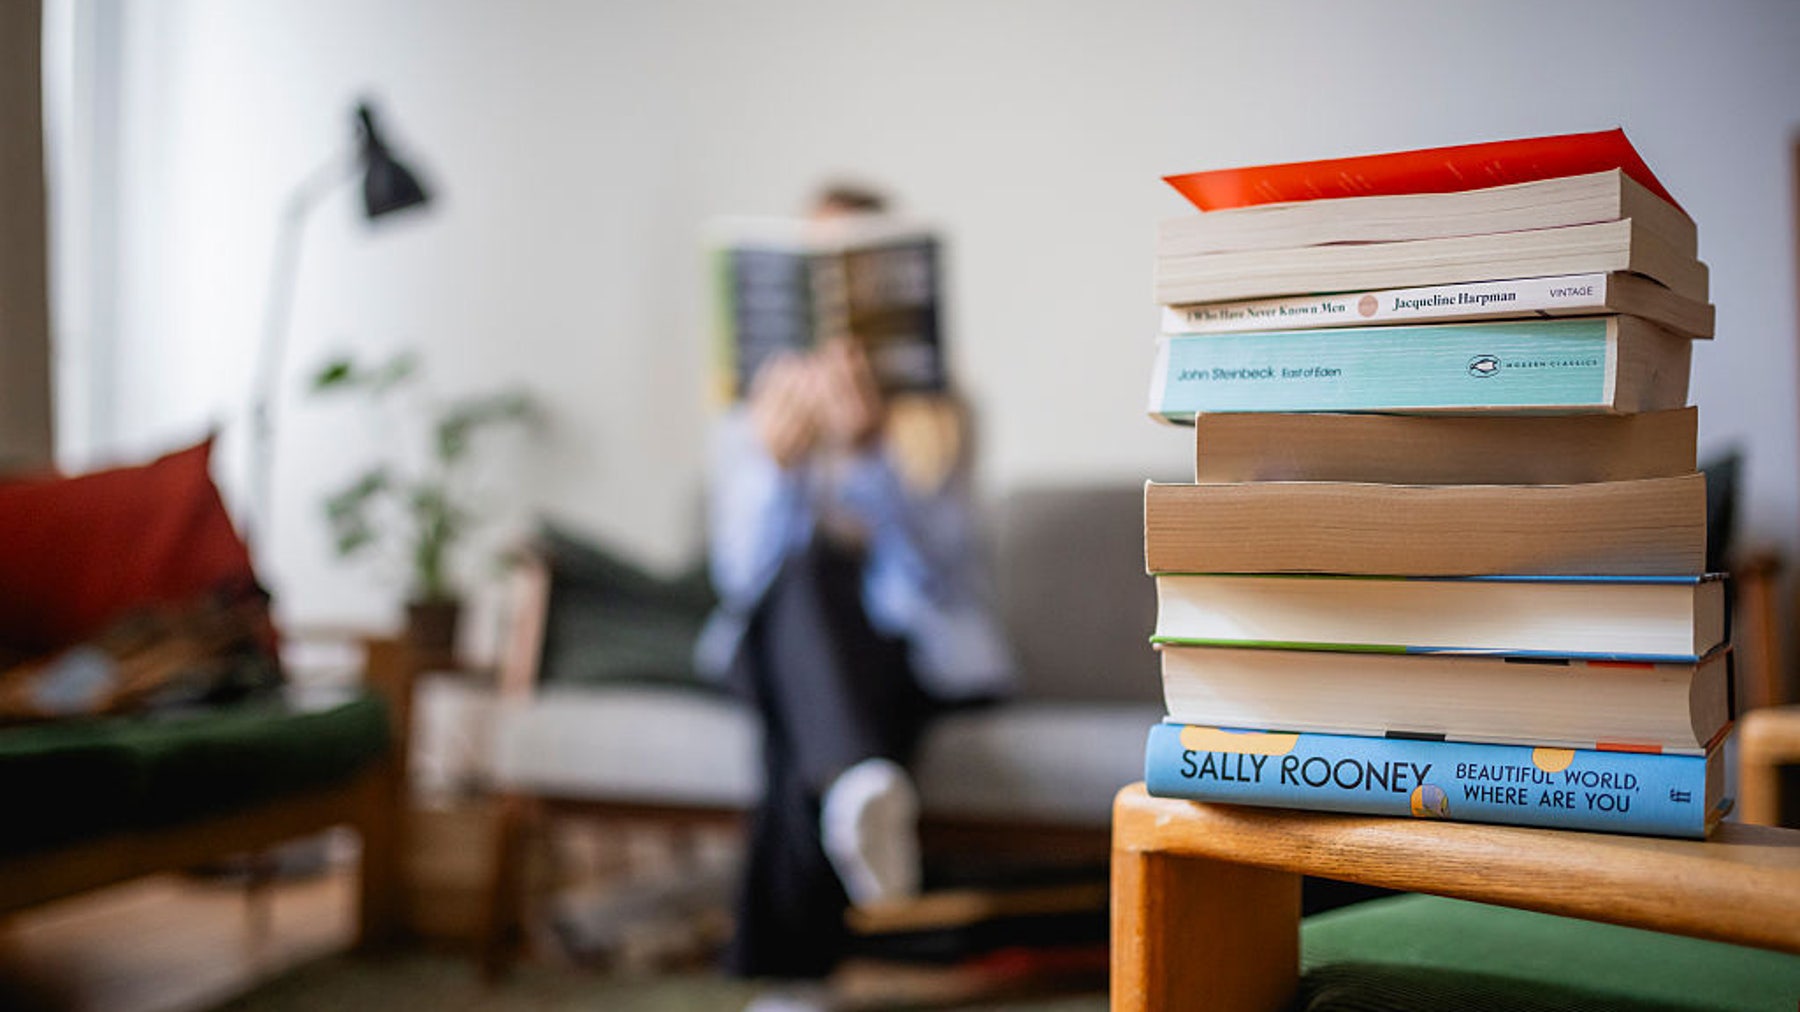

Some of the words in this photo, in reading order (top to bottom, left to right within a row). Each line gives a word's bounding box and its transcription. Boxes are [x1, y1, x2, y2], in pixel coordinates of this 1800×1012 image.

[1550, 286, 1593, 298] VINTAGE
[1247, 308, 1276, 319] Never
[1279, 305, 1318, 316] Known
[1320, 302, 1346, 313] Men
[1392, 294, 1456, 311] Jacqueline
[1458, 292, 1516, 306] Harpman
[1178, 368, 1210, 381] John
[1212, 366, 1274, 380] Steinbeck
[1282, 367, 1302, 378] East
[1303, 366, 1314, 378] of
[1314, 366, 1342, 377] Eden
[1180, 750, 1269, 783] SALLY
[1280, 755, 1433, 793] ROONEY
[1456, 763, 1555, 785] BEAUTIFUL
[1564, 768, 1640, 793] WORLD,
[1463, 784, 1528, 806] WHERE
[1539, 790, 1576, 809] ARE
[1585, 792, 1631, 813] YOU
